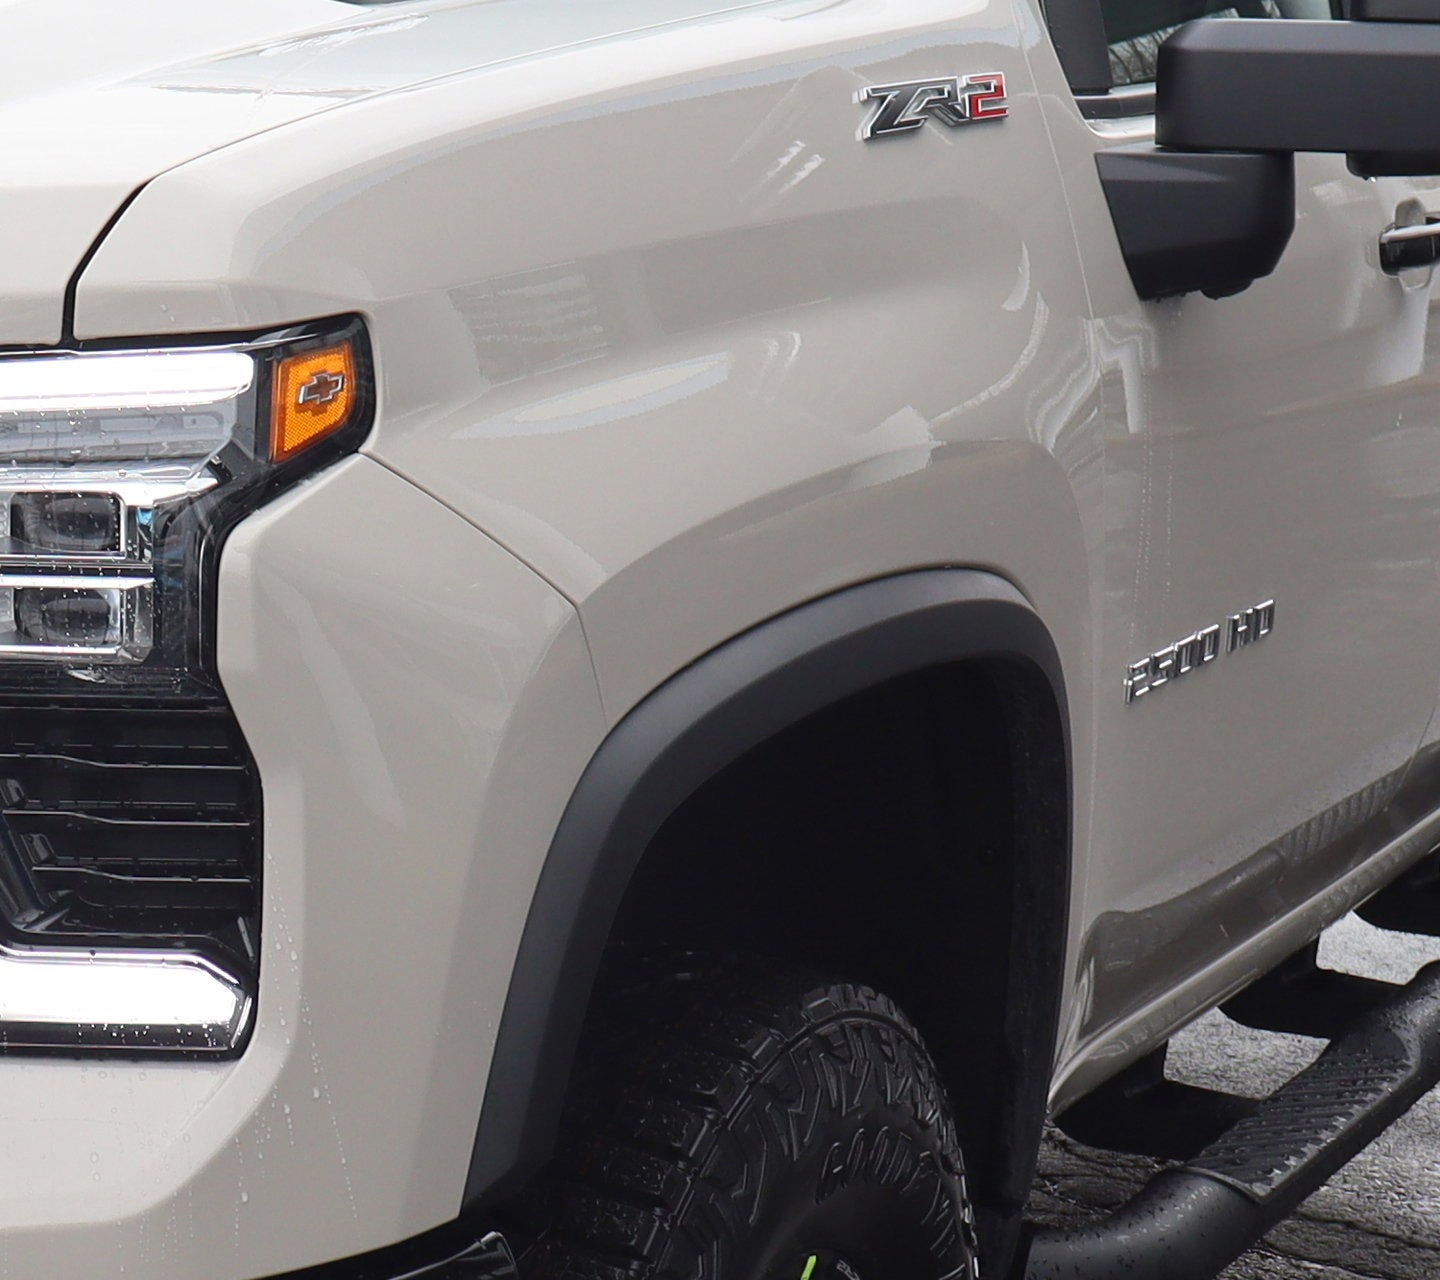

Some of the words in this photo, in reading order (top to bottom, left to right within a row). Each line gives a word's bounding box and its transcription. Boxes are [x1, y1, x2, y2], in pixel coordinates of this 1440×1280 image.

[852, 71, 1009, 141] ZR2
[1123, 623, 1220, 704] 2500
[1225, 599, 1275, 654] HD
